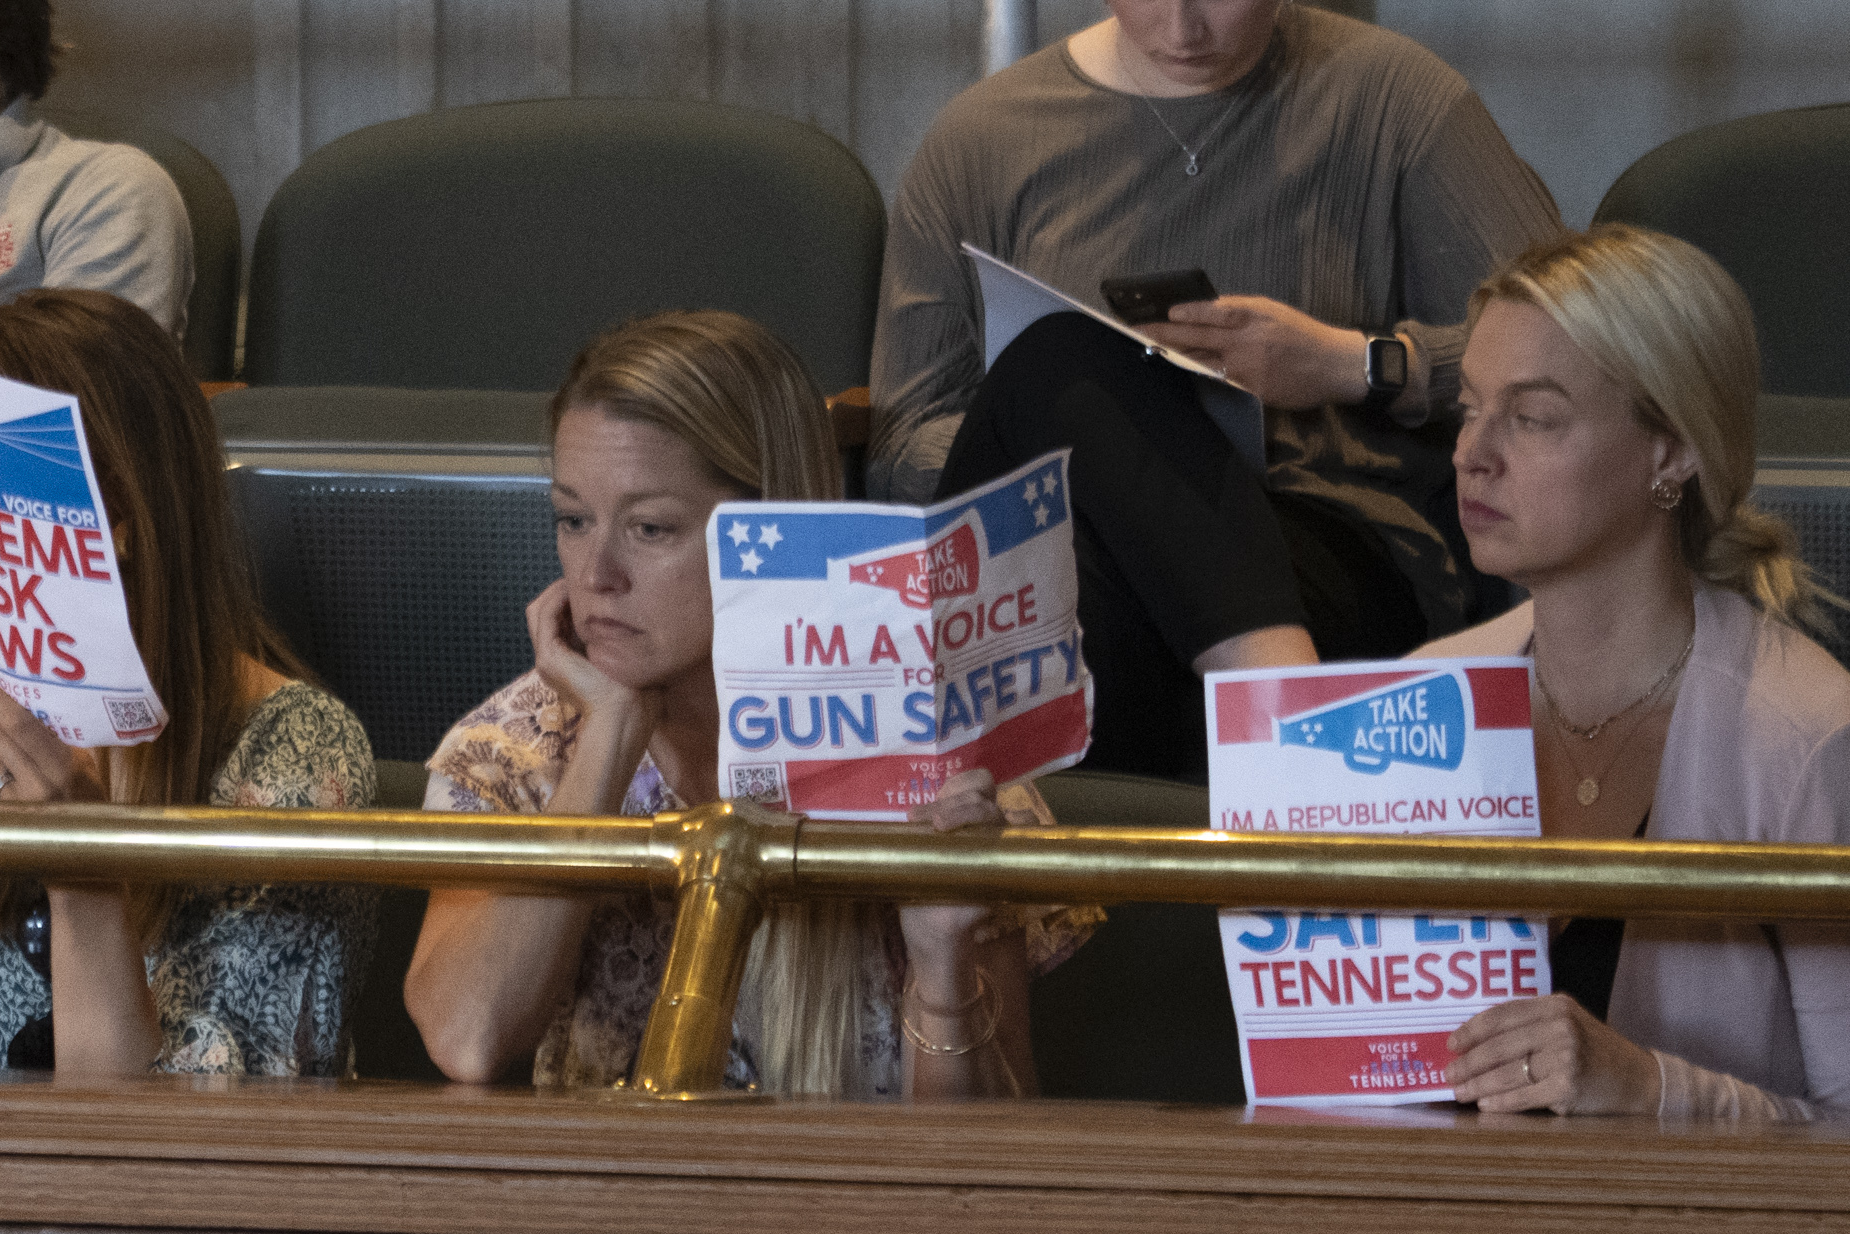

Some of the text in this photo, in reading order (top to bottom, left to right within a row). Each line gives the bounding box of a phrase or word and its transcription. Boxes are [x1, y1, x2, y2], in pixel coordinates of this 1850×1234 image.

[1, 493, 52, 521] VOICE
[56, 506, 96, 528] FOR
[915, 538, 954, 573] TAKE
[906, 567, 968, 596] ACTION
[784, 584, 1037, 666] I'M A VOICE
[728, 632, 1081, 753] GUN SAFETY
[903, 664, 945, 687] FOR
[1368, 688, 1428, 724] TAKE
[1353, 725, 1447, 760] ACTION
[910, 757, 962, 772] VOICES
[1221, 796, 1534, 832] I'M A REPUBLICAN VOICE
[1239, 949, 1538, 1007] TENNESSEE
[1368, 1042, 1418, 1054] VOICES
